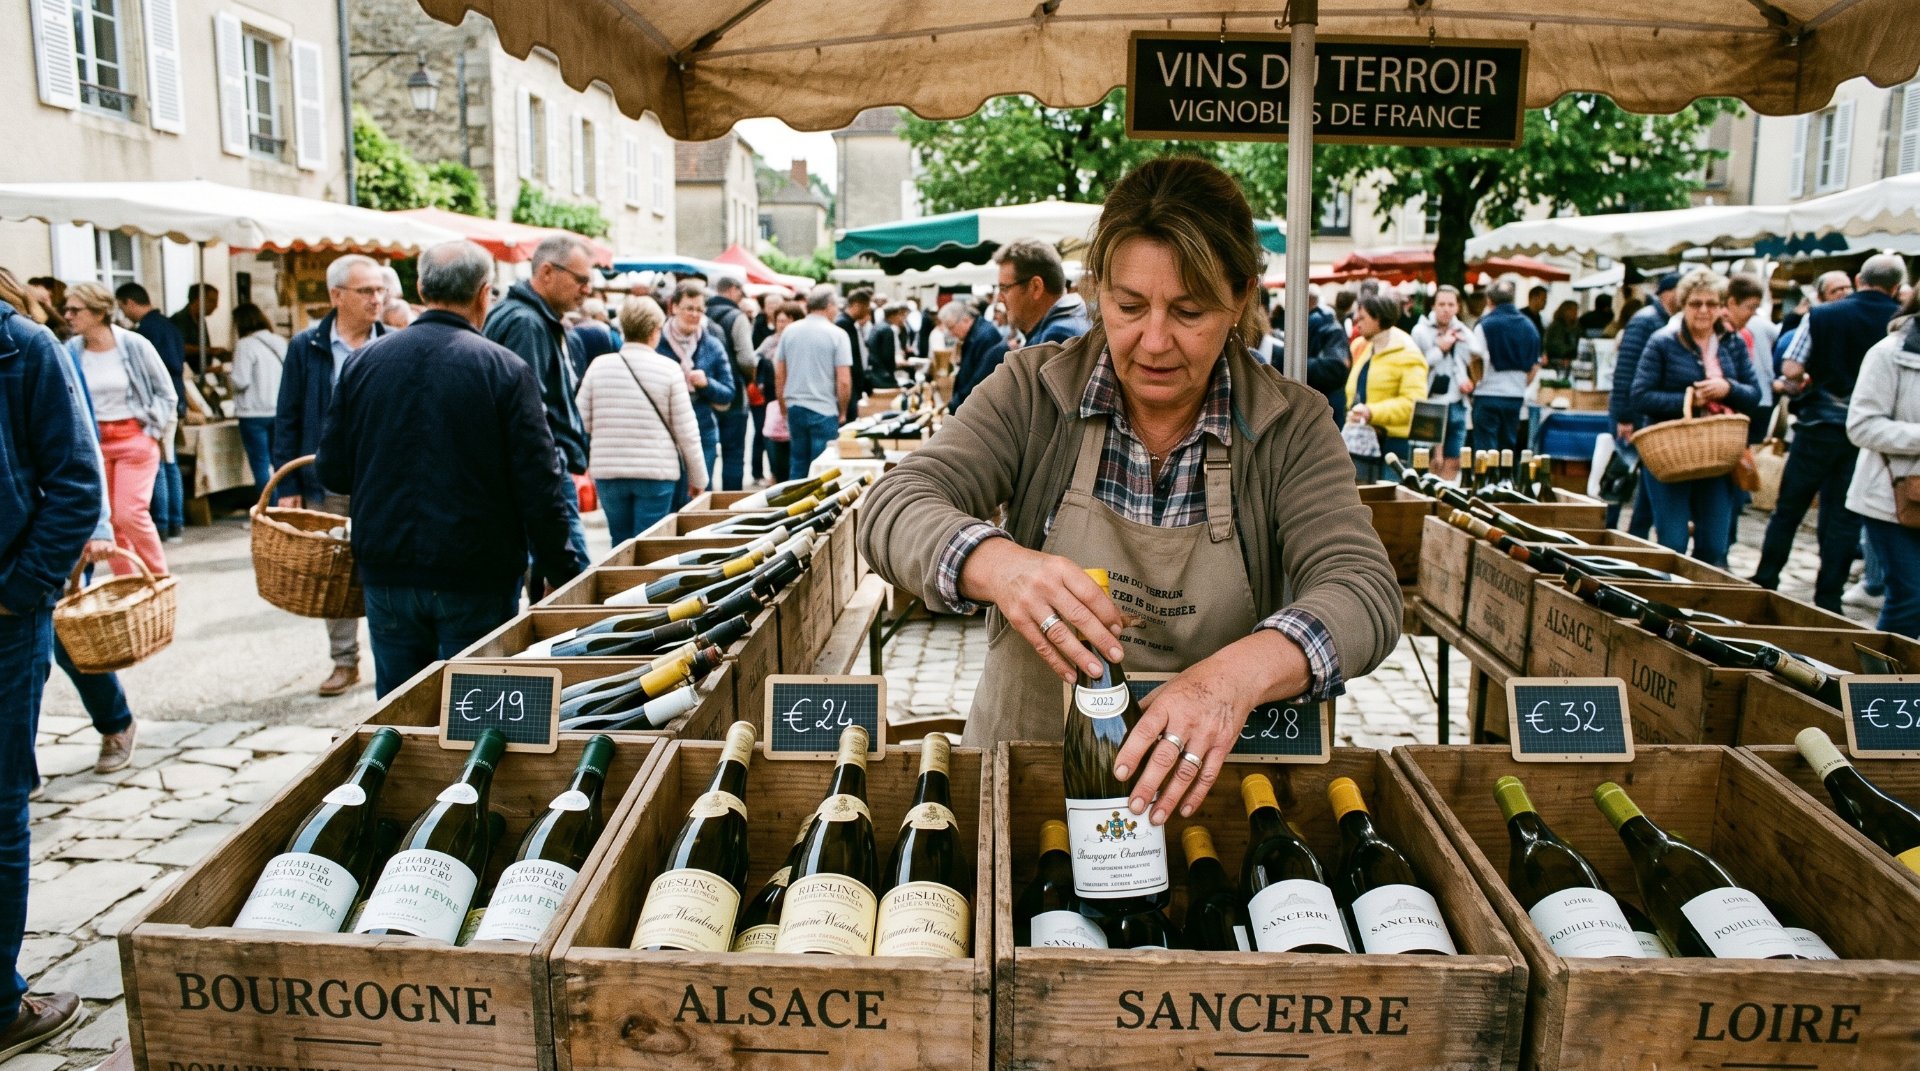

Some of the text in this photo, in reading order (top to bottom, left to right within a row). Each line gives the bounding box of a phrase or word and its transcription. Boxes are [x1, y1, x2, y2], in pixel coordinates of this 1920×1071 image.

[1156, 50, 1248, 90] VINS
[1330, 56, 1498, 96] TERROIR
[1168, 98, 1481, 129] VIGNOBLS DE FRANCE
[1544, 605, 1594, 653] ALSACE
[1631, 658, 1678, 710] LOIRE
[1090, 696, 1115, 706] 2022
[276, 859, 330, 875] CHABLIS
[398, 856, 451, 872] CHABLIS
[266, 868, 305, 878] GRAND
[308, 872, 333, 887] CRU
[388, 865, 427, 876] GRAND
[430, 868, 453, 882] CRU
[511, 866, 565, 881] CHABLIS
[502, 875, 540, 887] GRAND
[543, 877, 567, 892] CRU
[655, 878, 718, 894] RIESLING
[798, 882, 861, 900] RIESLING
[893, 891, 956, 908] RIESLING
[1564, 897, 1594, 907] LOIRE
[1722, 896, 1750, 905] LOIRE
[1262, 911, 1332, 934] SANCERRE
[1371, 916, 1443, 936] SANCERRE
[175, 971, 498, 1027] BOURGOGNE
[672, 983, 888, 1031] ALSACE
[1115, 989, 1410, 1036] SANCERRE
[1693, 1001, 1862, 1044] LOIRE
